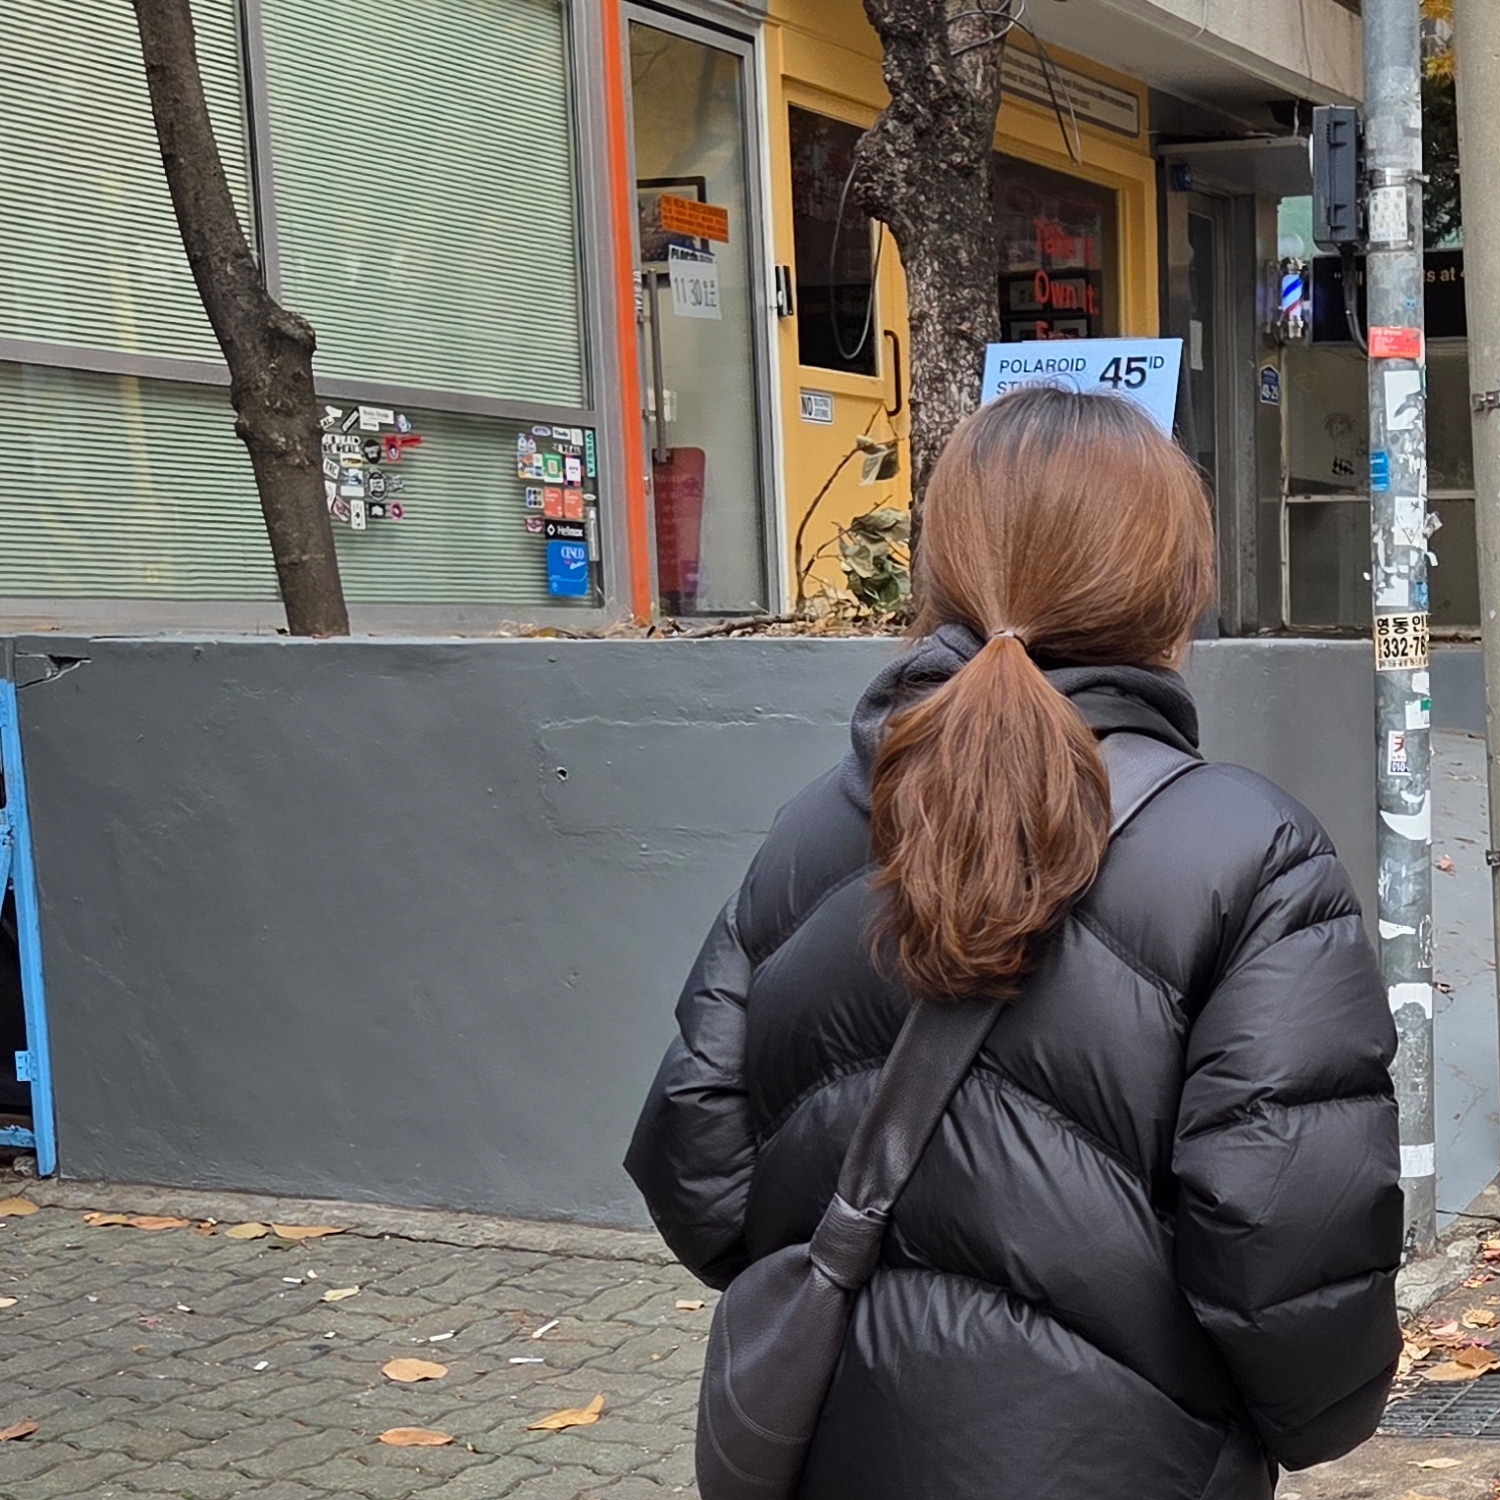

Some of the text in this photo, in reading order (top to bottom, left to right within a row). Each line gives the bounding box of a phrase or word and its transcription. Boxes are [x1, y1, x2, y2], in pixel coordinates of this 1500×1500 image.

[1440, 266, 1456, 282] at
[1034, 270, 1078, 309] Own
[999, 358, 1087, 374] POLAROID
[1377, 615, 1428, 635] 영동인
